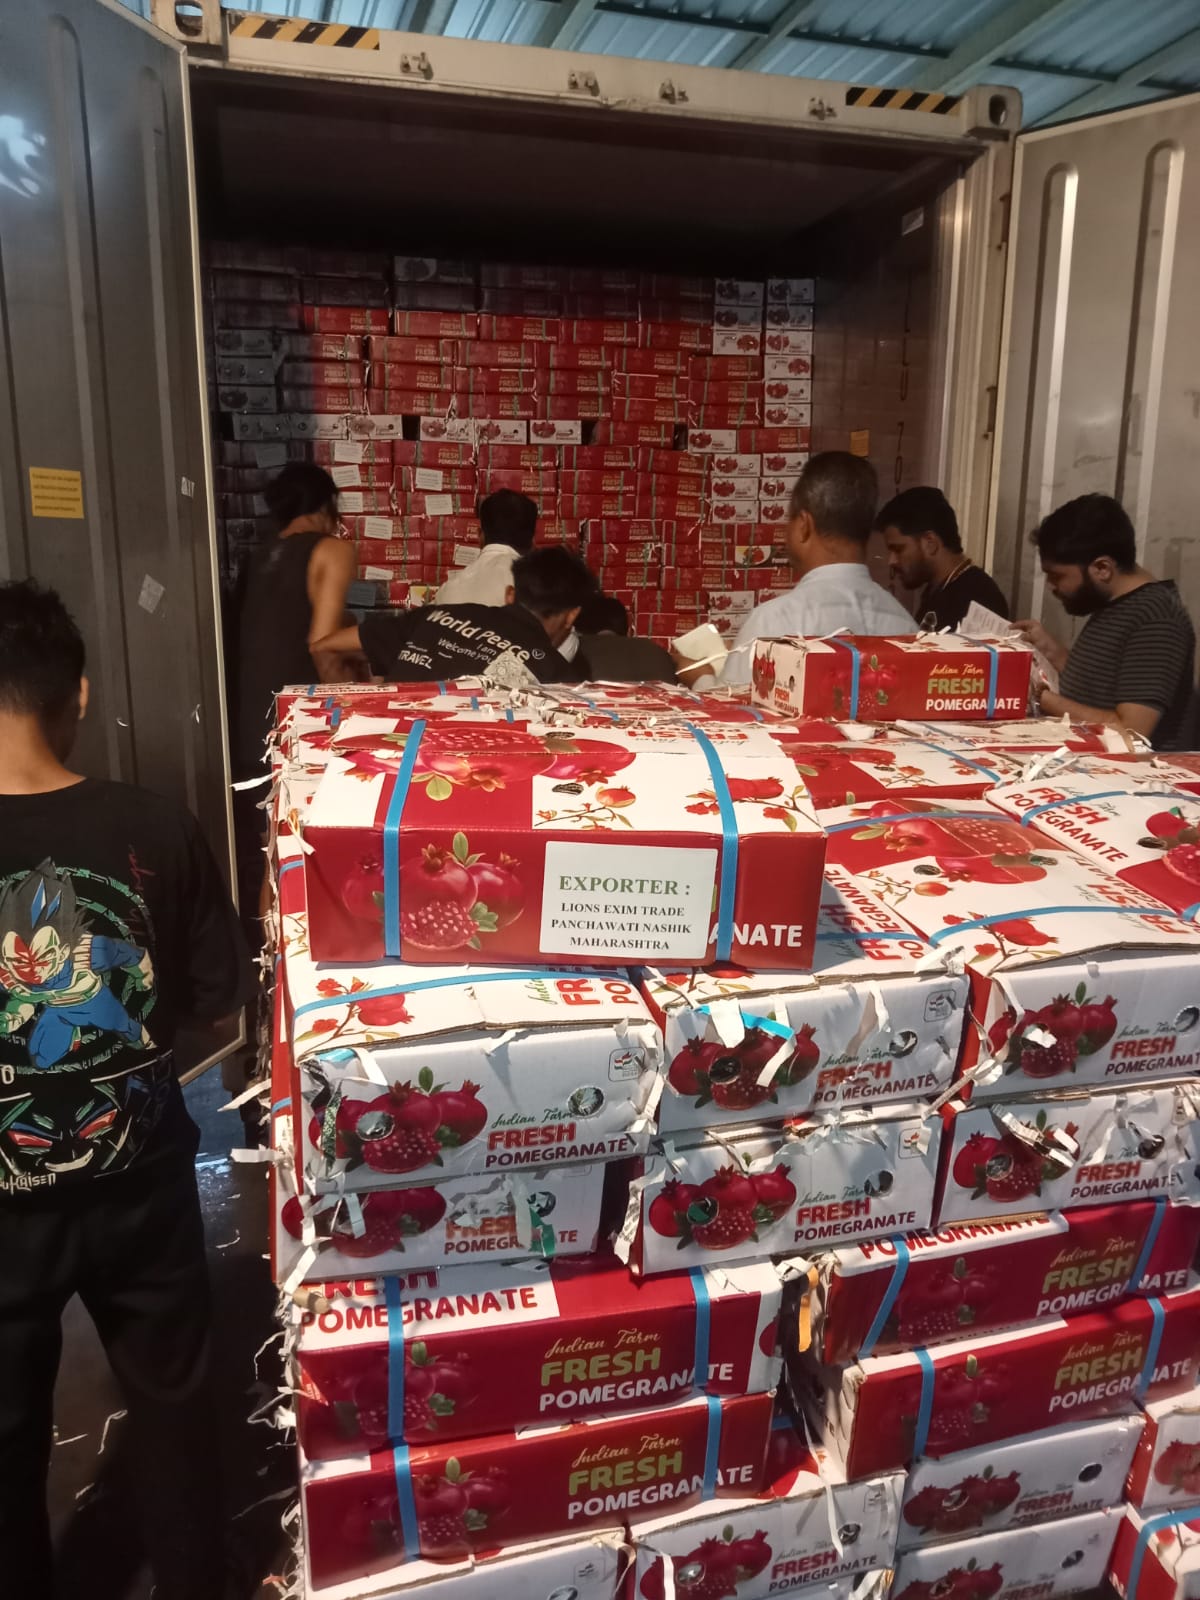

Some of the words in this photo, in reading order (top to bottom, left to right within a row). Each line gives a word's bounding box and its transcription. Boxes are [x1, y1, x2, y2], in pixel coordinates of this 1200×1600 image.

[426, 610, 482, 639] World
[475, 630, 530, 661] Peace
[438, 637, 476, 657] Welcome
[399, 649, 433, 669] TRAVEL
[482, 645, 497, 656] am
[927, 678, 985, 695] FRESH
[925, 697, 1021, 711] POMEGRAATE
[1028, 787, 1109, 825] FRSH
[559, 875, 679, 896] EXPORTER
[561, 902, 600, 913] LIONS
[604, 904, 638, 915] EXIM
[641, 905, 685, 917] TRADE
[824, 869, 925, 959] POEGRANATE
[551, 919, 639, 932] PANCHAWATI
[642, 923, 692, 934] NASHIK
[569, 936, 670, 950] MAHARASHTRA
[1110, 1035, 1177, 1060] FRESH
[1105, 1052, 1200, 1076] POMEGRANAT
[491, 1113, 536, 1128] Indian
[487, 1121, 577, 1151] FRESH
[485, 1138, 629, 1168] POMEGRANATE
[1075, 1161, 1142, 1184] FRESH
[796, 1197, 871, 1226] FRESH
[794, 1211, 916, 1242] POMEGRANATE
[444, 1229, 578, 1255] POMEGRTE
[1041, 1253, 1135, 1294] FRESH
[545, 1336, 606, 1359] Indian
[614, 1327, 662, 1349] Farm
[541, 1346, 662, 1387] FRESH
[1053, 1346, 1143, 1391] FRESH
[539, 1362, 735, 1412] POMEGRANTE
[572, 1444, 630, 1469] Indian
[637, 1433, 681, 1455] Farm
[568, 1450, 684, 1496] FRESH
[1014, 1490, 1075, 1515] FRESH
[768, 1554, 878, 1592] POMEGRANATE
[770, 1549, 839, 1580] FRESH
